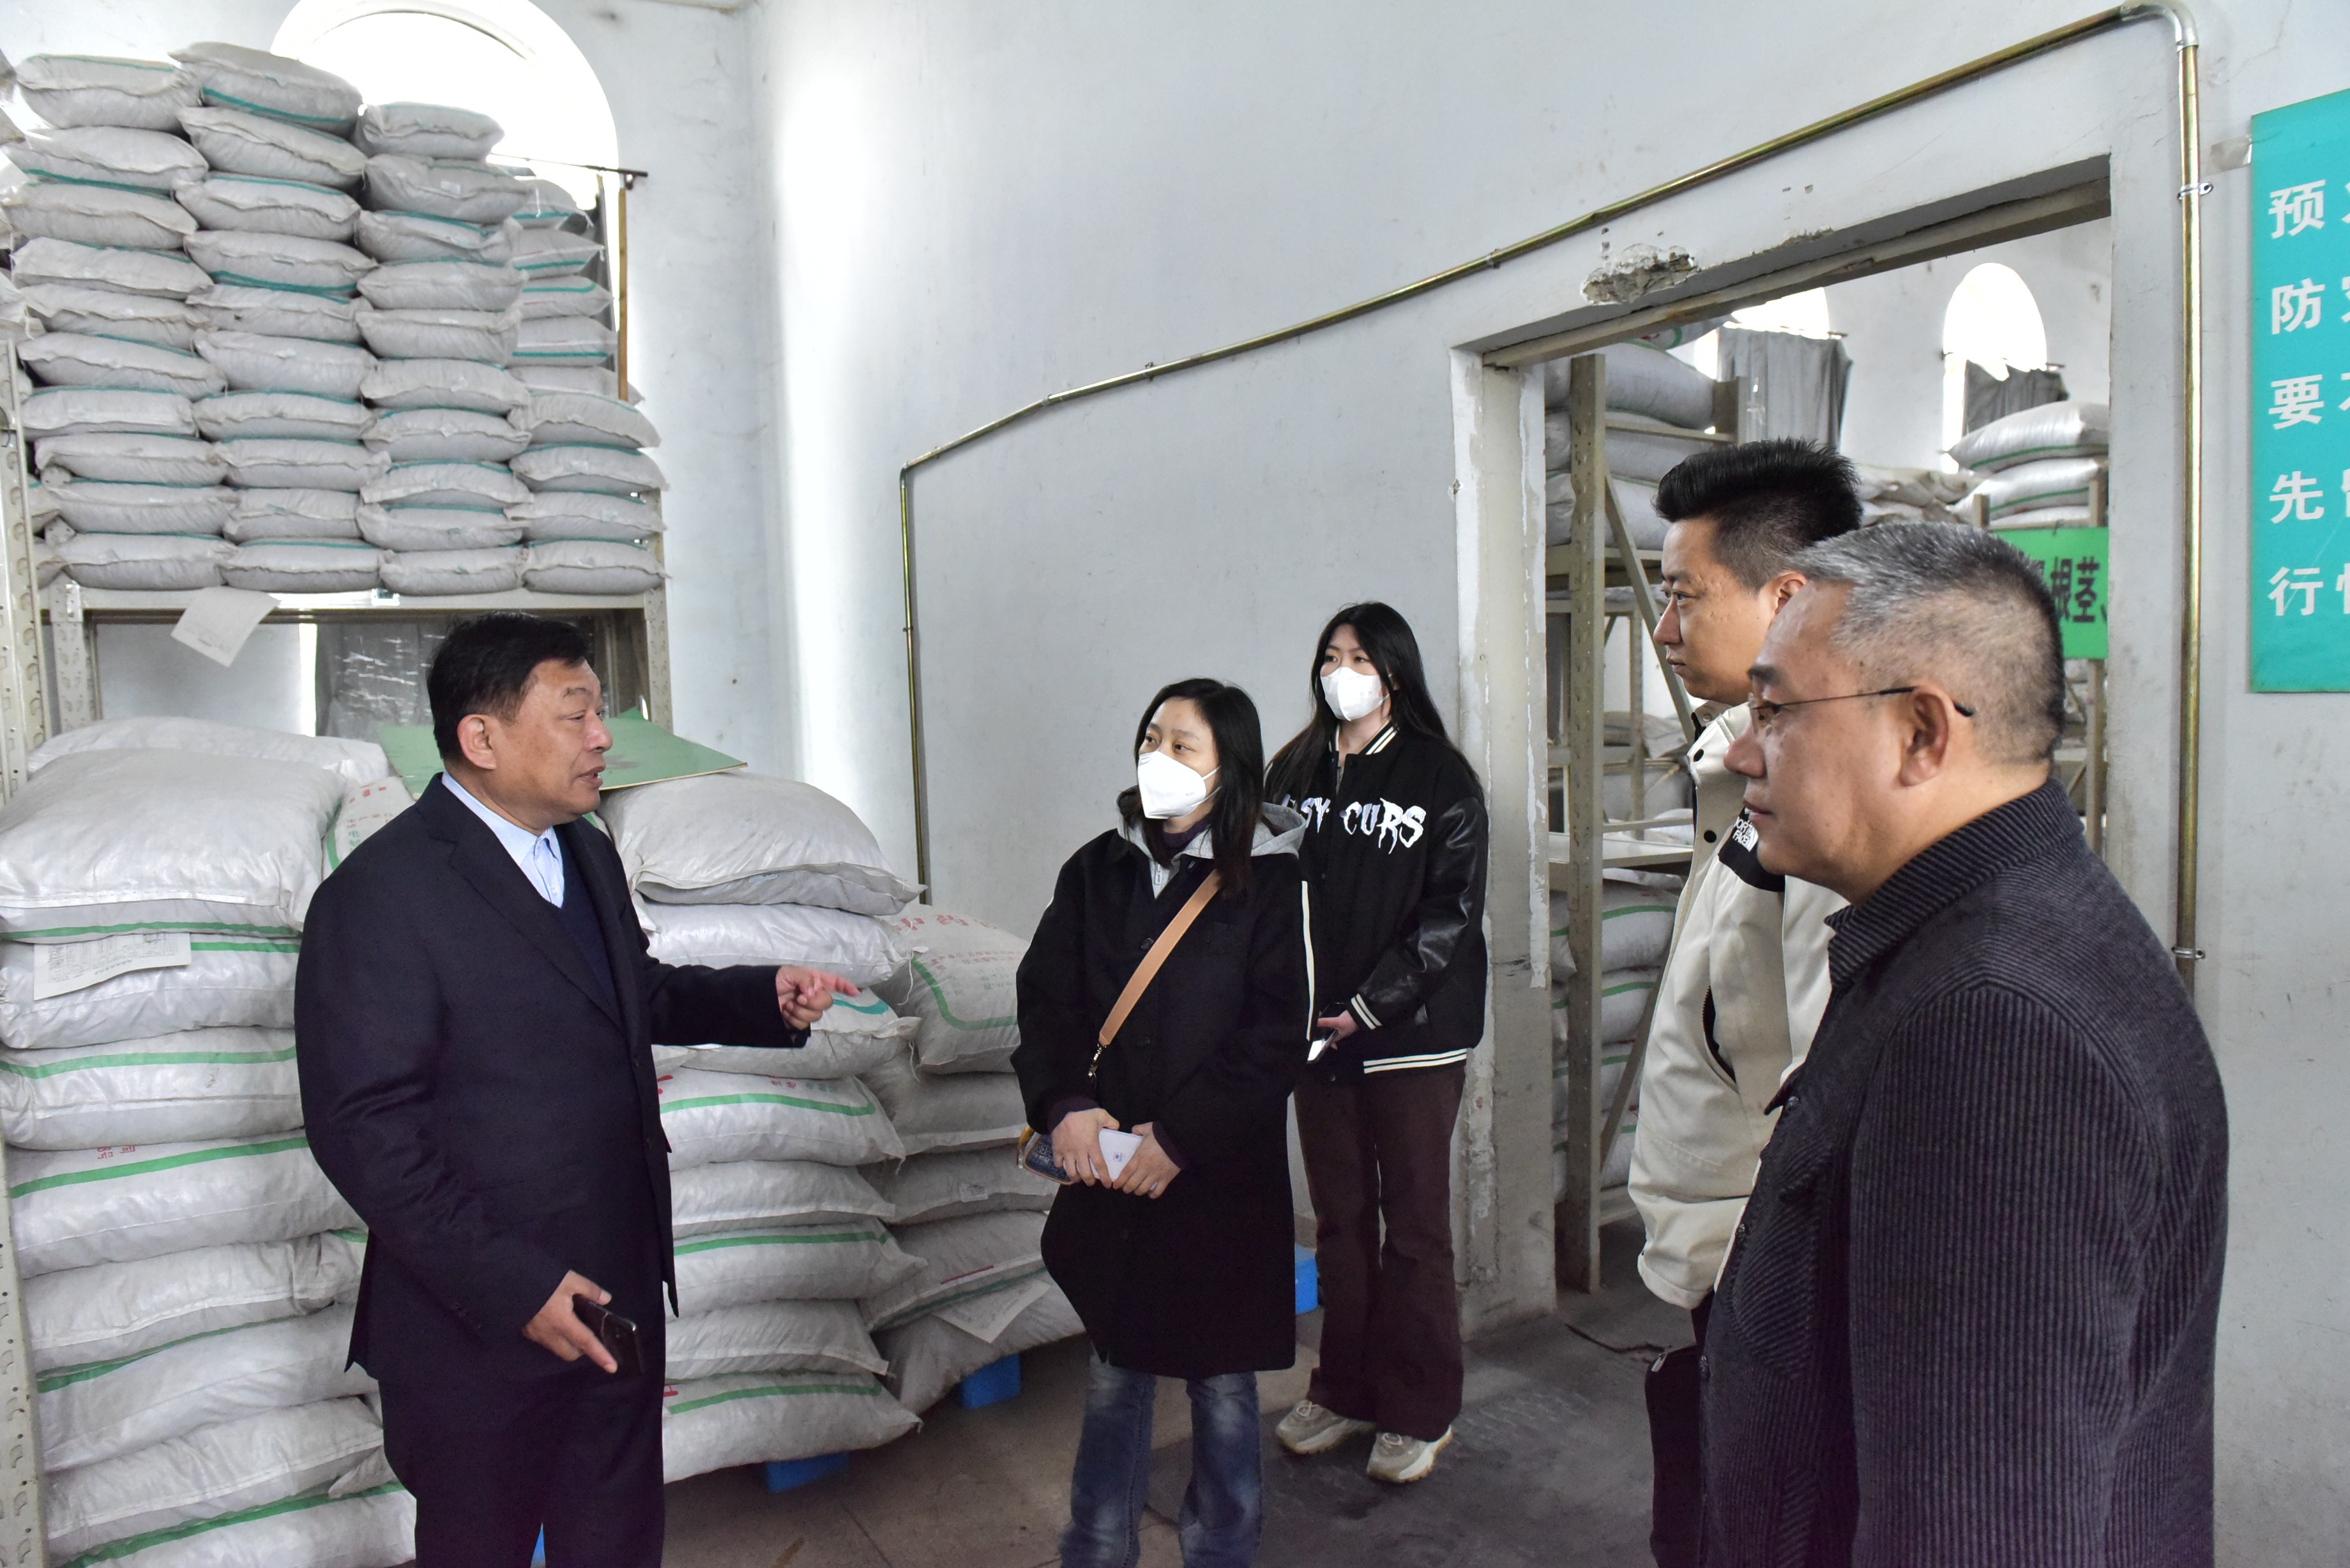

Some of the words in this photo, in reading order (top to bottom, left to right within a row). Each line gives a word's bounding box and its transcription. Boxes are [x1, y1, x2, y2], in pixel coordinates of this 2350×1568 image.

[2268, 179, 2326, 617] 预防要先行
[1344, 797, 1427, 855] CURS
